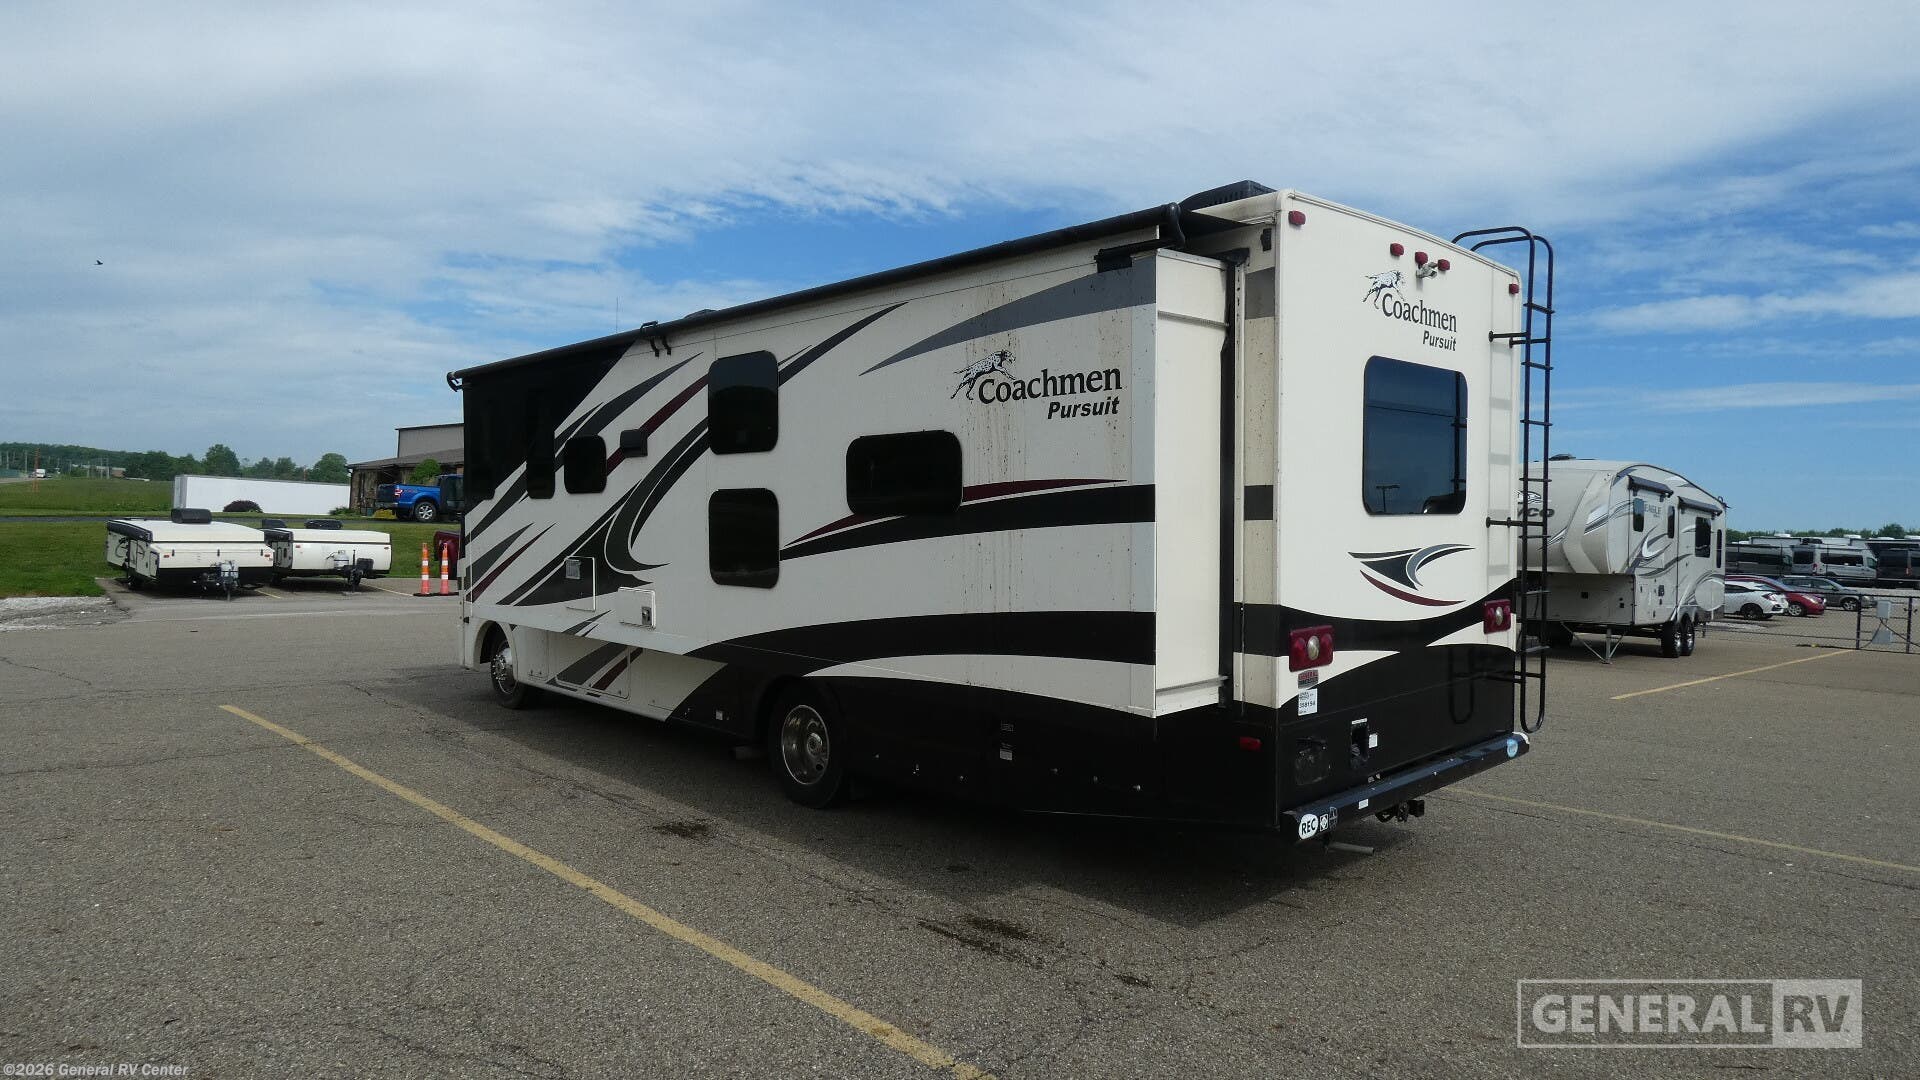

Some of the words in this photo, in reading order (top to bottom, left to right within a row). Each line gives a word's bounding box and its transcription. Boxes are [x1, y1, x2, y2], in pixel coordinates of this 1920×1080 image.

[1382, 293, 1457, 333] Coachmen
[1423, 330, 1457, 351] Pursuit
[978, 368, 1122, 404] Coachmen
[1047, 396, 1120, 420] Pursuit
[1301, 818, 1316, 835] REC
